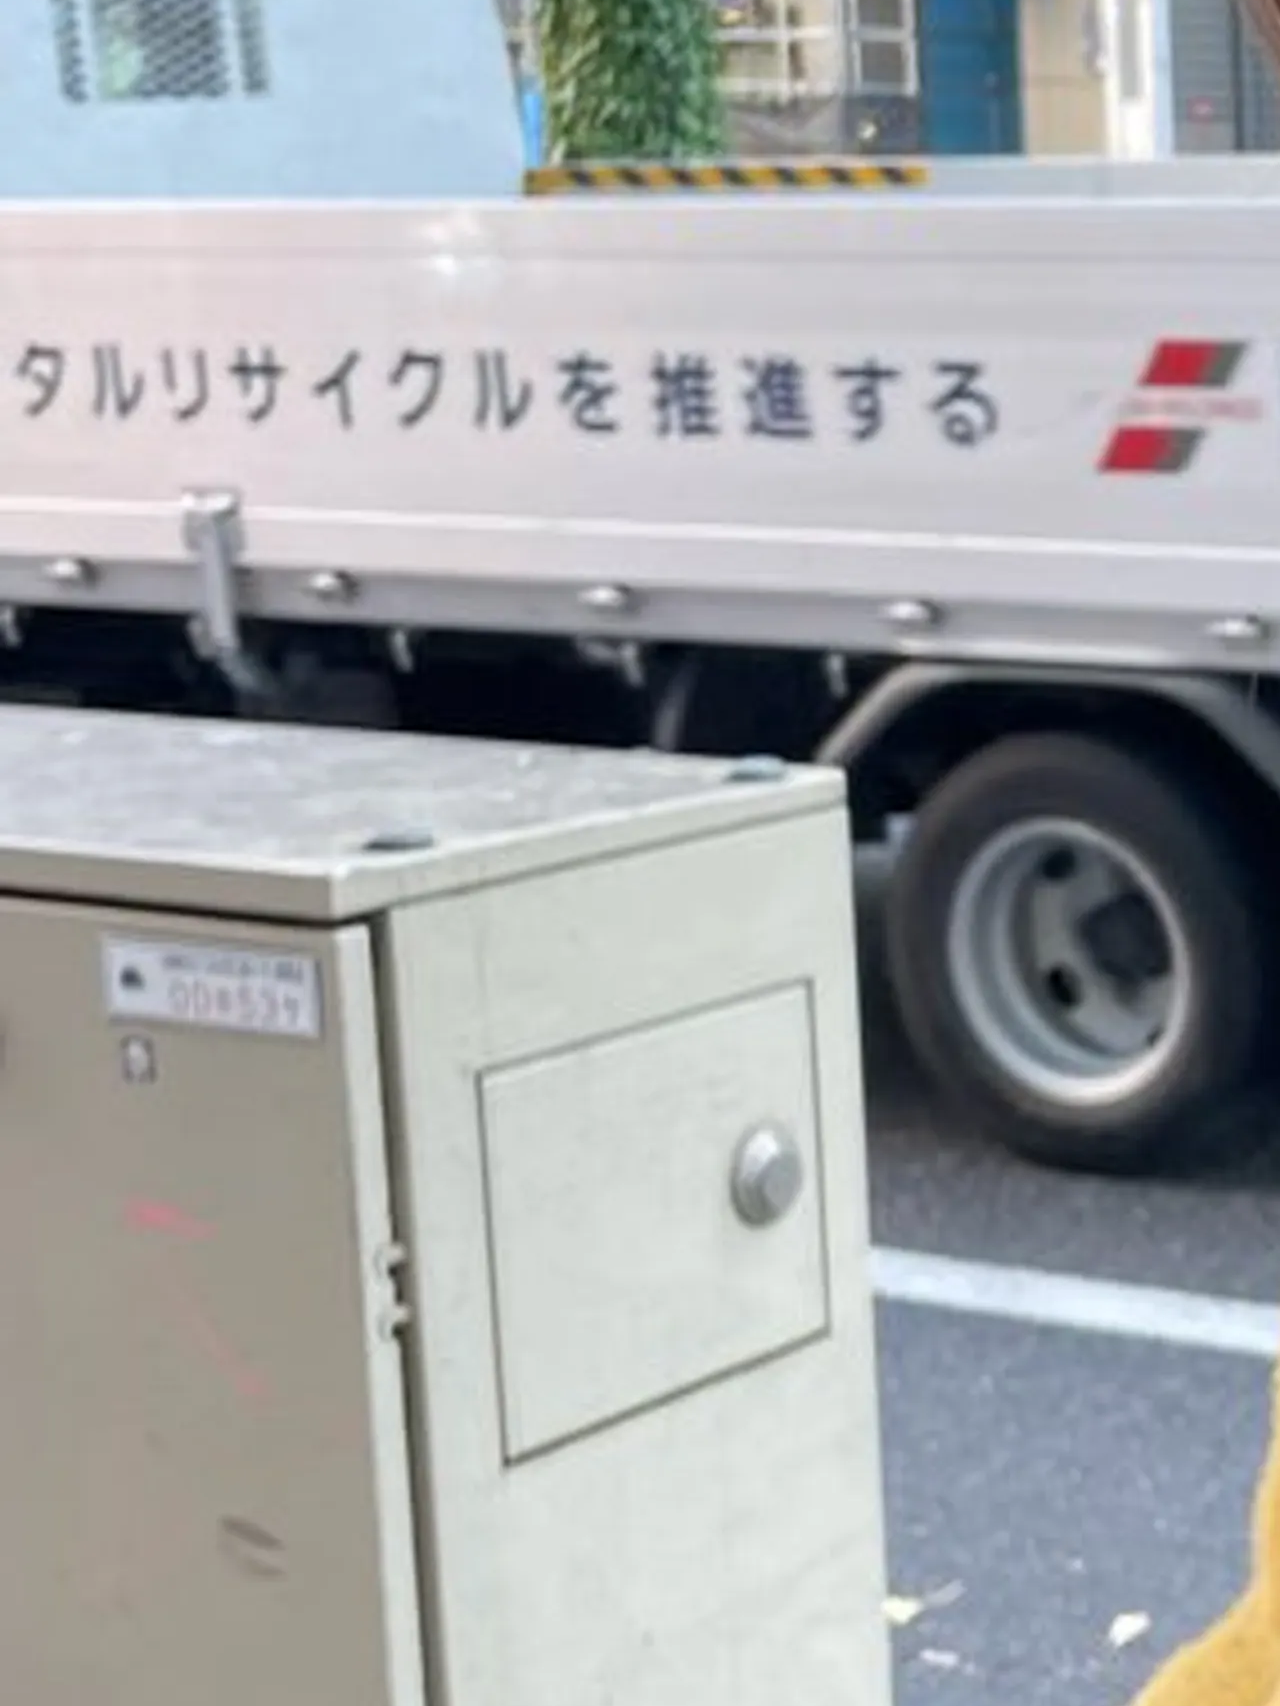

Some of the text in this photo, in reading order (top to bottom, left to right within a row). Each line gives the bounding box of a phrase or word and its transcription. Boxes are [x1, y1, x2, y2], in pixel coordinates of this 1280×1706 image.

[16, 343, 998, 446] タルリサイクルを推進する
